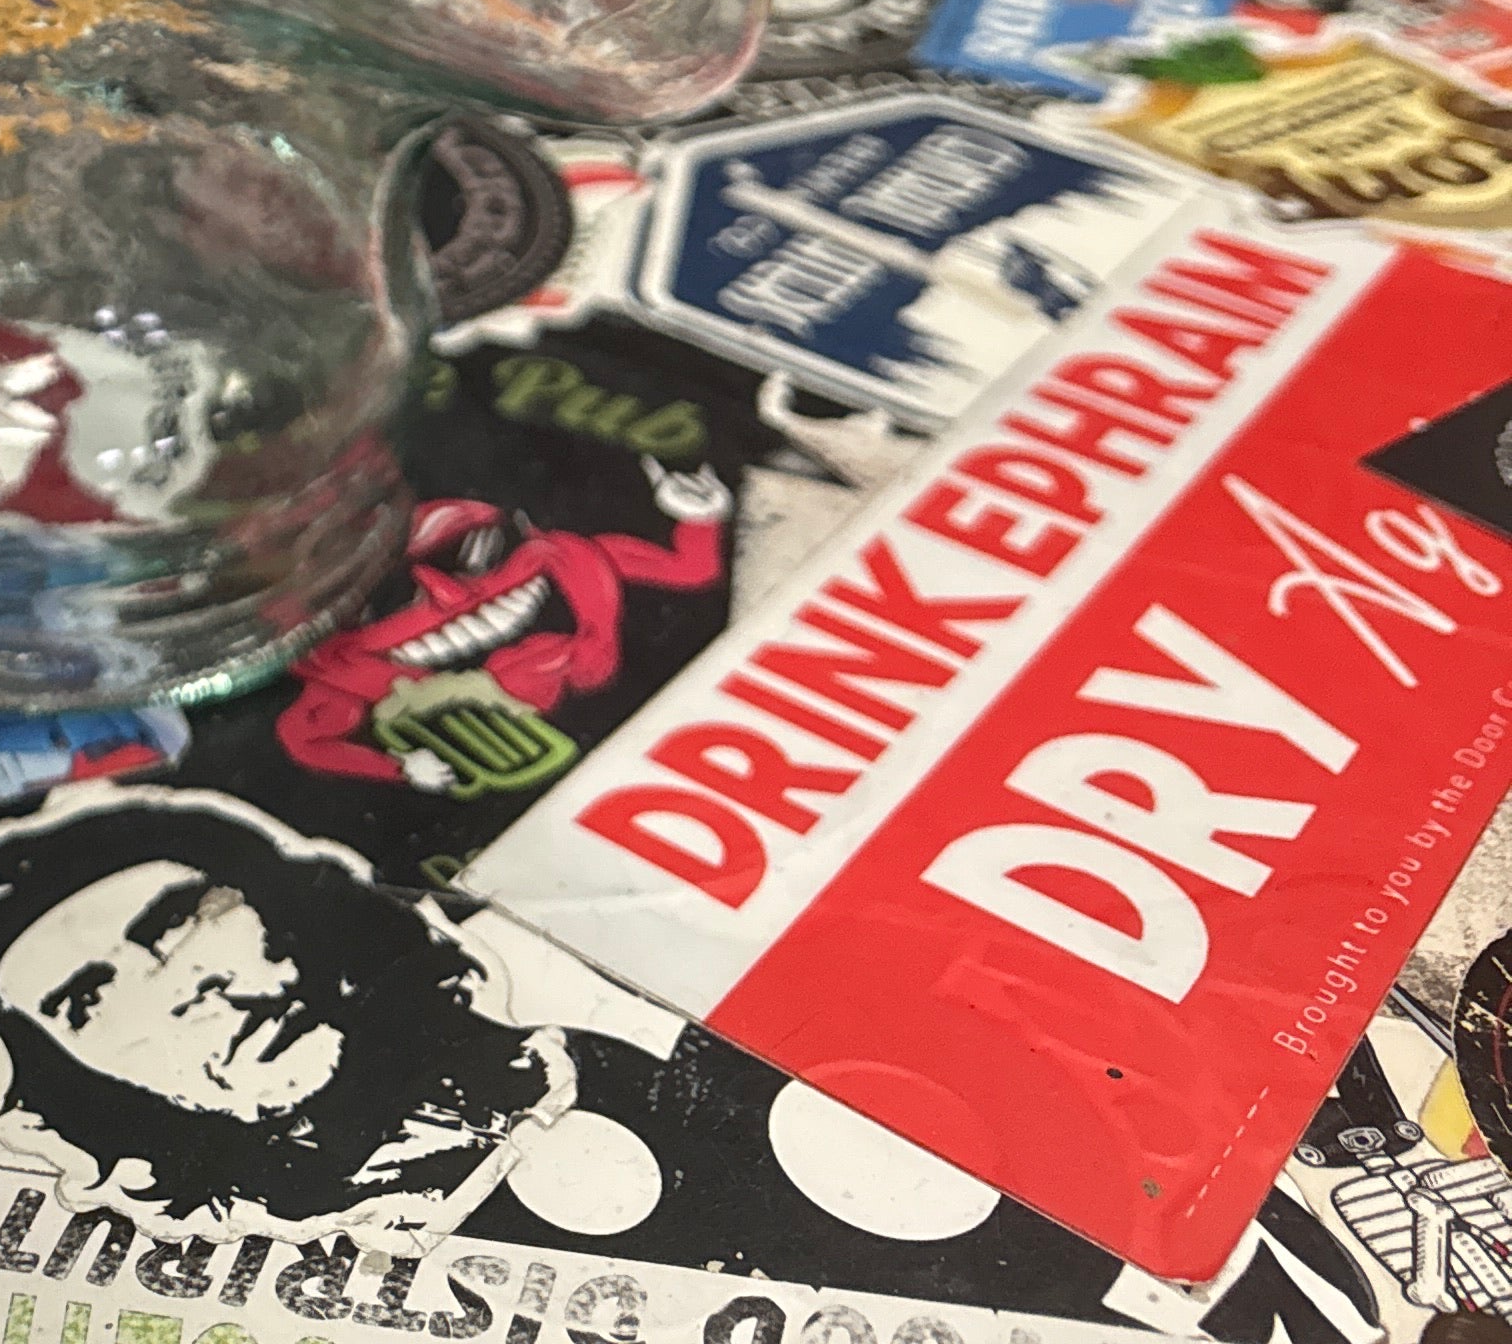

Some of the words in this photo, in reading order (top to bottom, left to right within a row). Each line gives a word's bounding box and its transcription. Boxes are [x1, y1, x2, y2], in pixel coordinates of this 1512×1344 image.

[494, 354, 706, 457] Pub
[573, 529, 1031, 911] DRINK
[899, 226, 1337, 580] EPHRAIM
[919, 601, 1360, 1005] DRY
[1272, 940, 1369, 1056] Brought
[1353, 906, 1387, 936] to
[1380, 856, 1423, 907] you
[1404, 816, 1454, 851] by
[1431, 772, 1474, 815] the
[1453, 714, 1508, 771] Door
